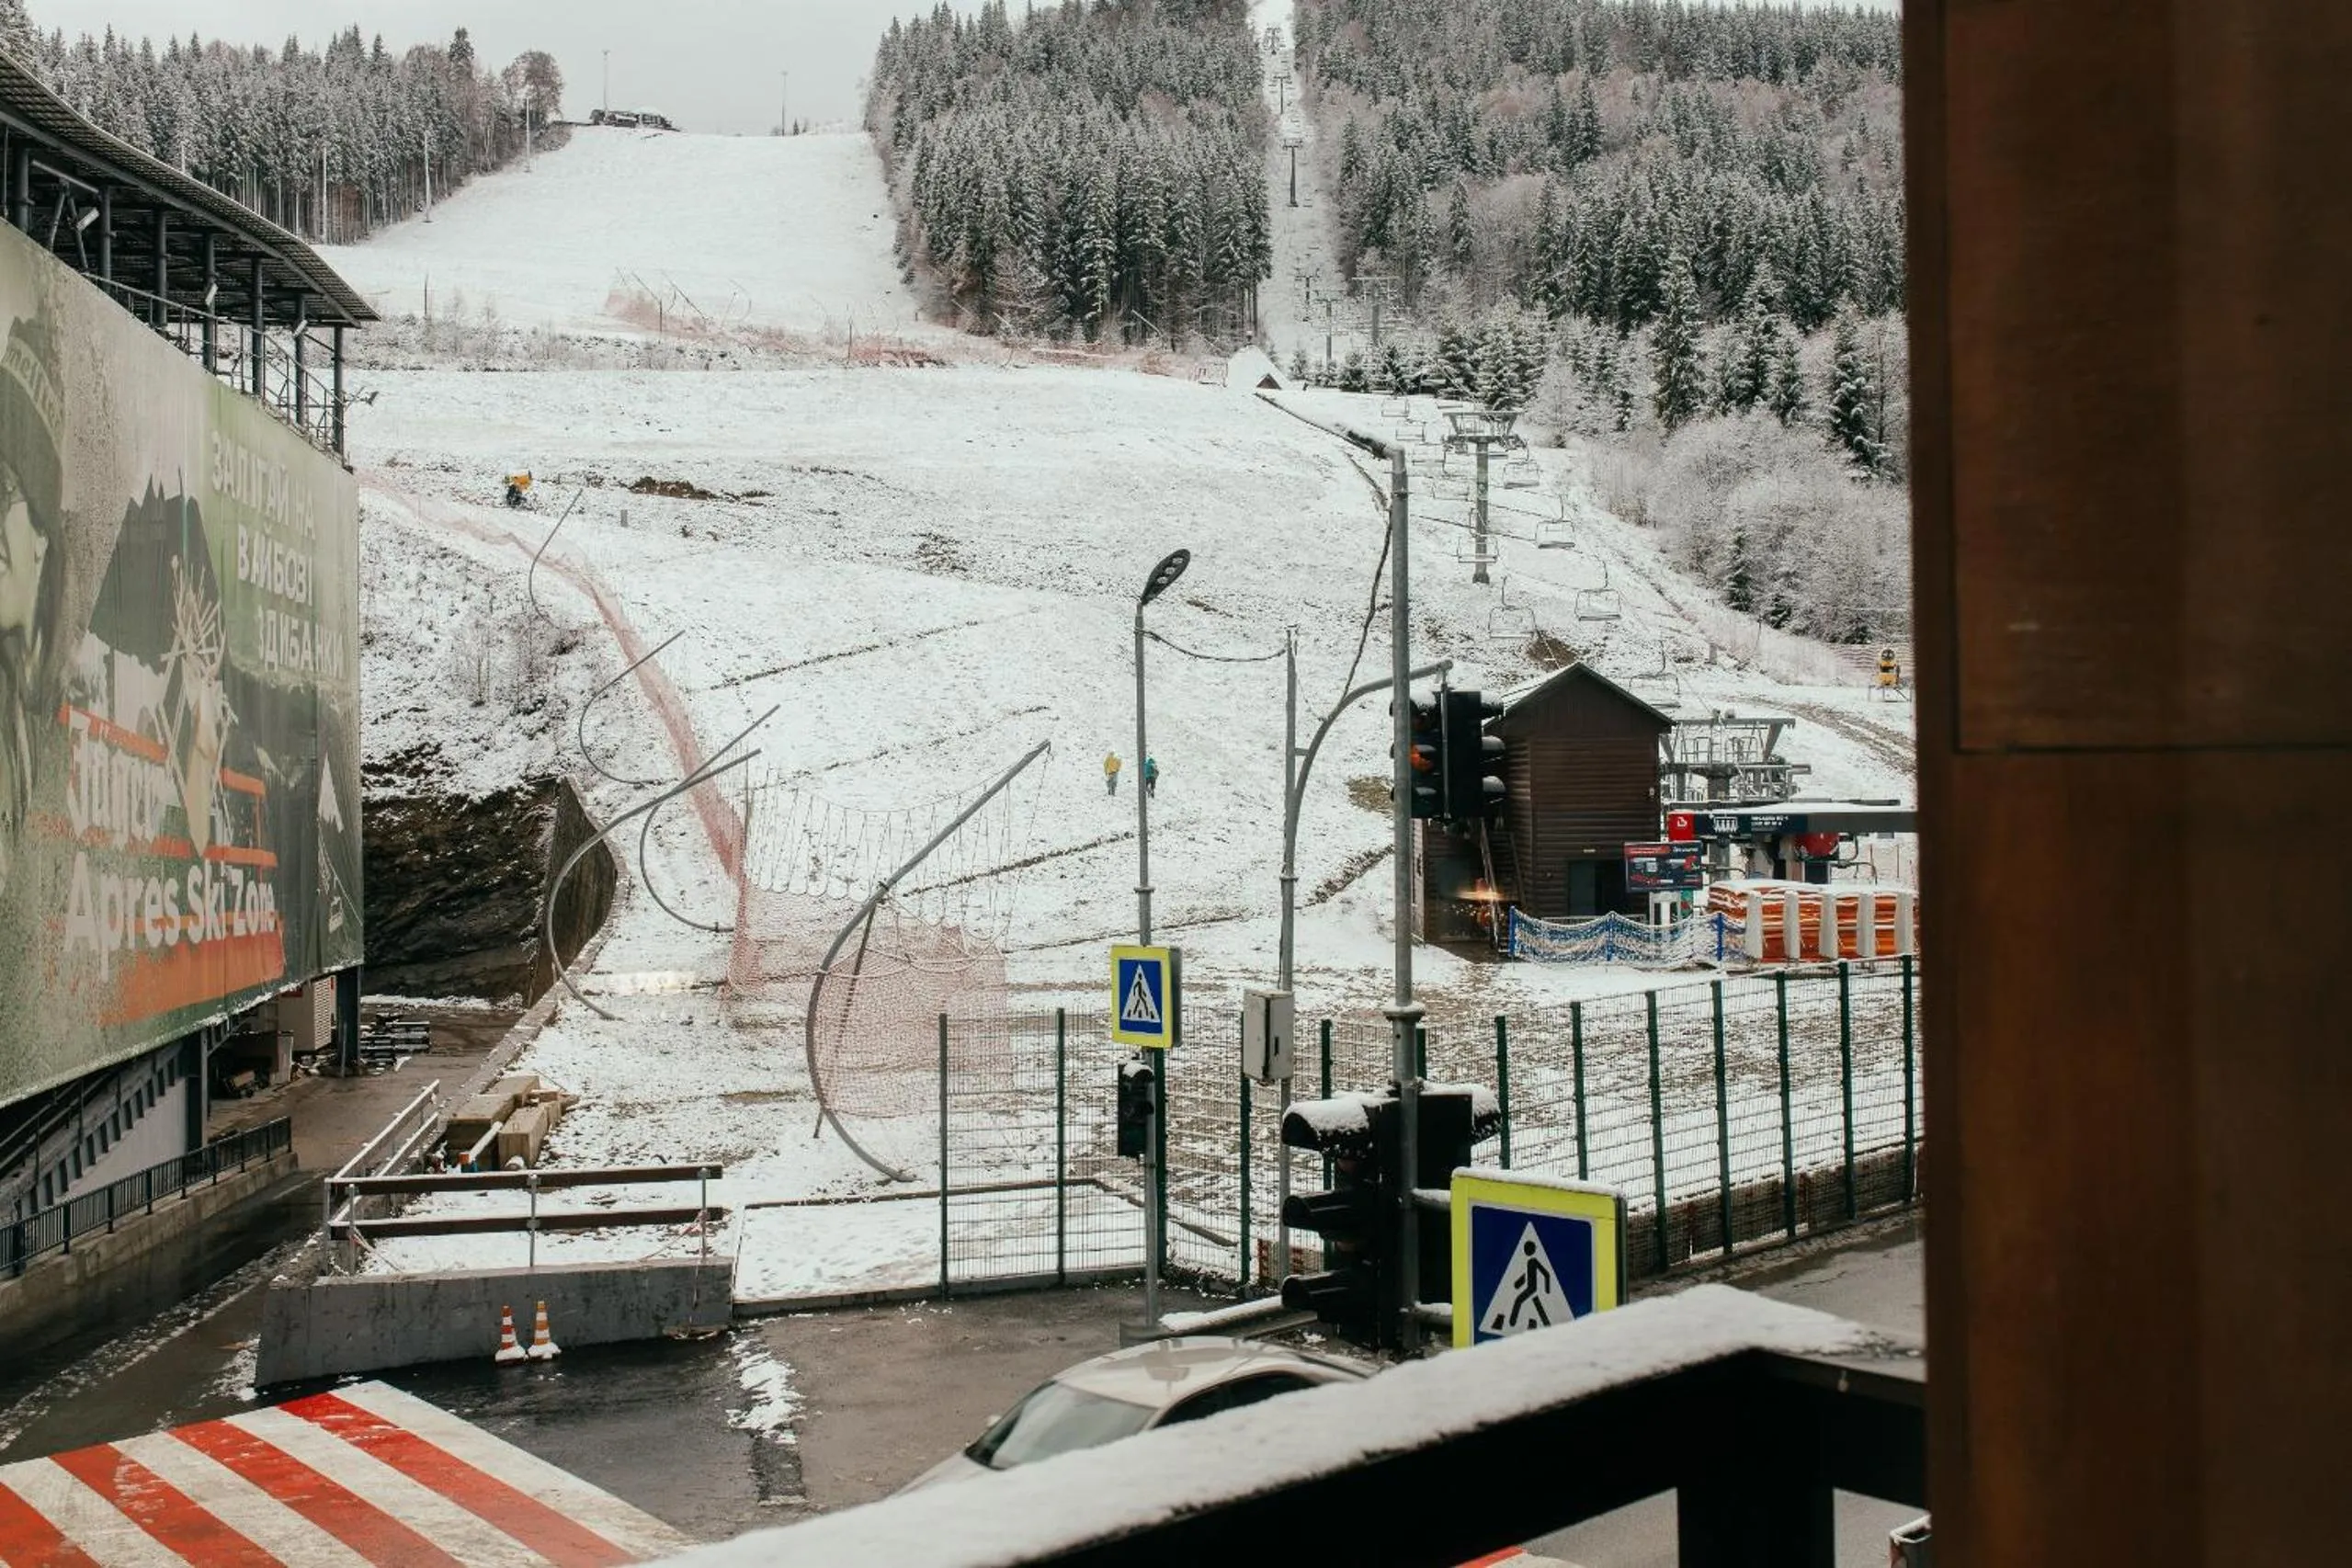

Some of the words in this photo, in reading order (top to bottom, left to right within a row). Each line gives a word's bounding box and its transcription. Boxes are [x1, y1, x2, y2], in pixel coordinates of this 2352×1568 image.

[295, 477, 316, 540] НА
[63, 851, 181, 983] Apres
[187, 859, 227, 945] Ski
[231, 868, 276, 938] Zone
